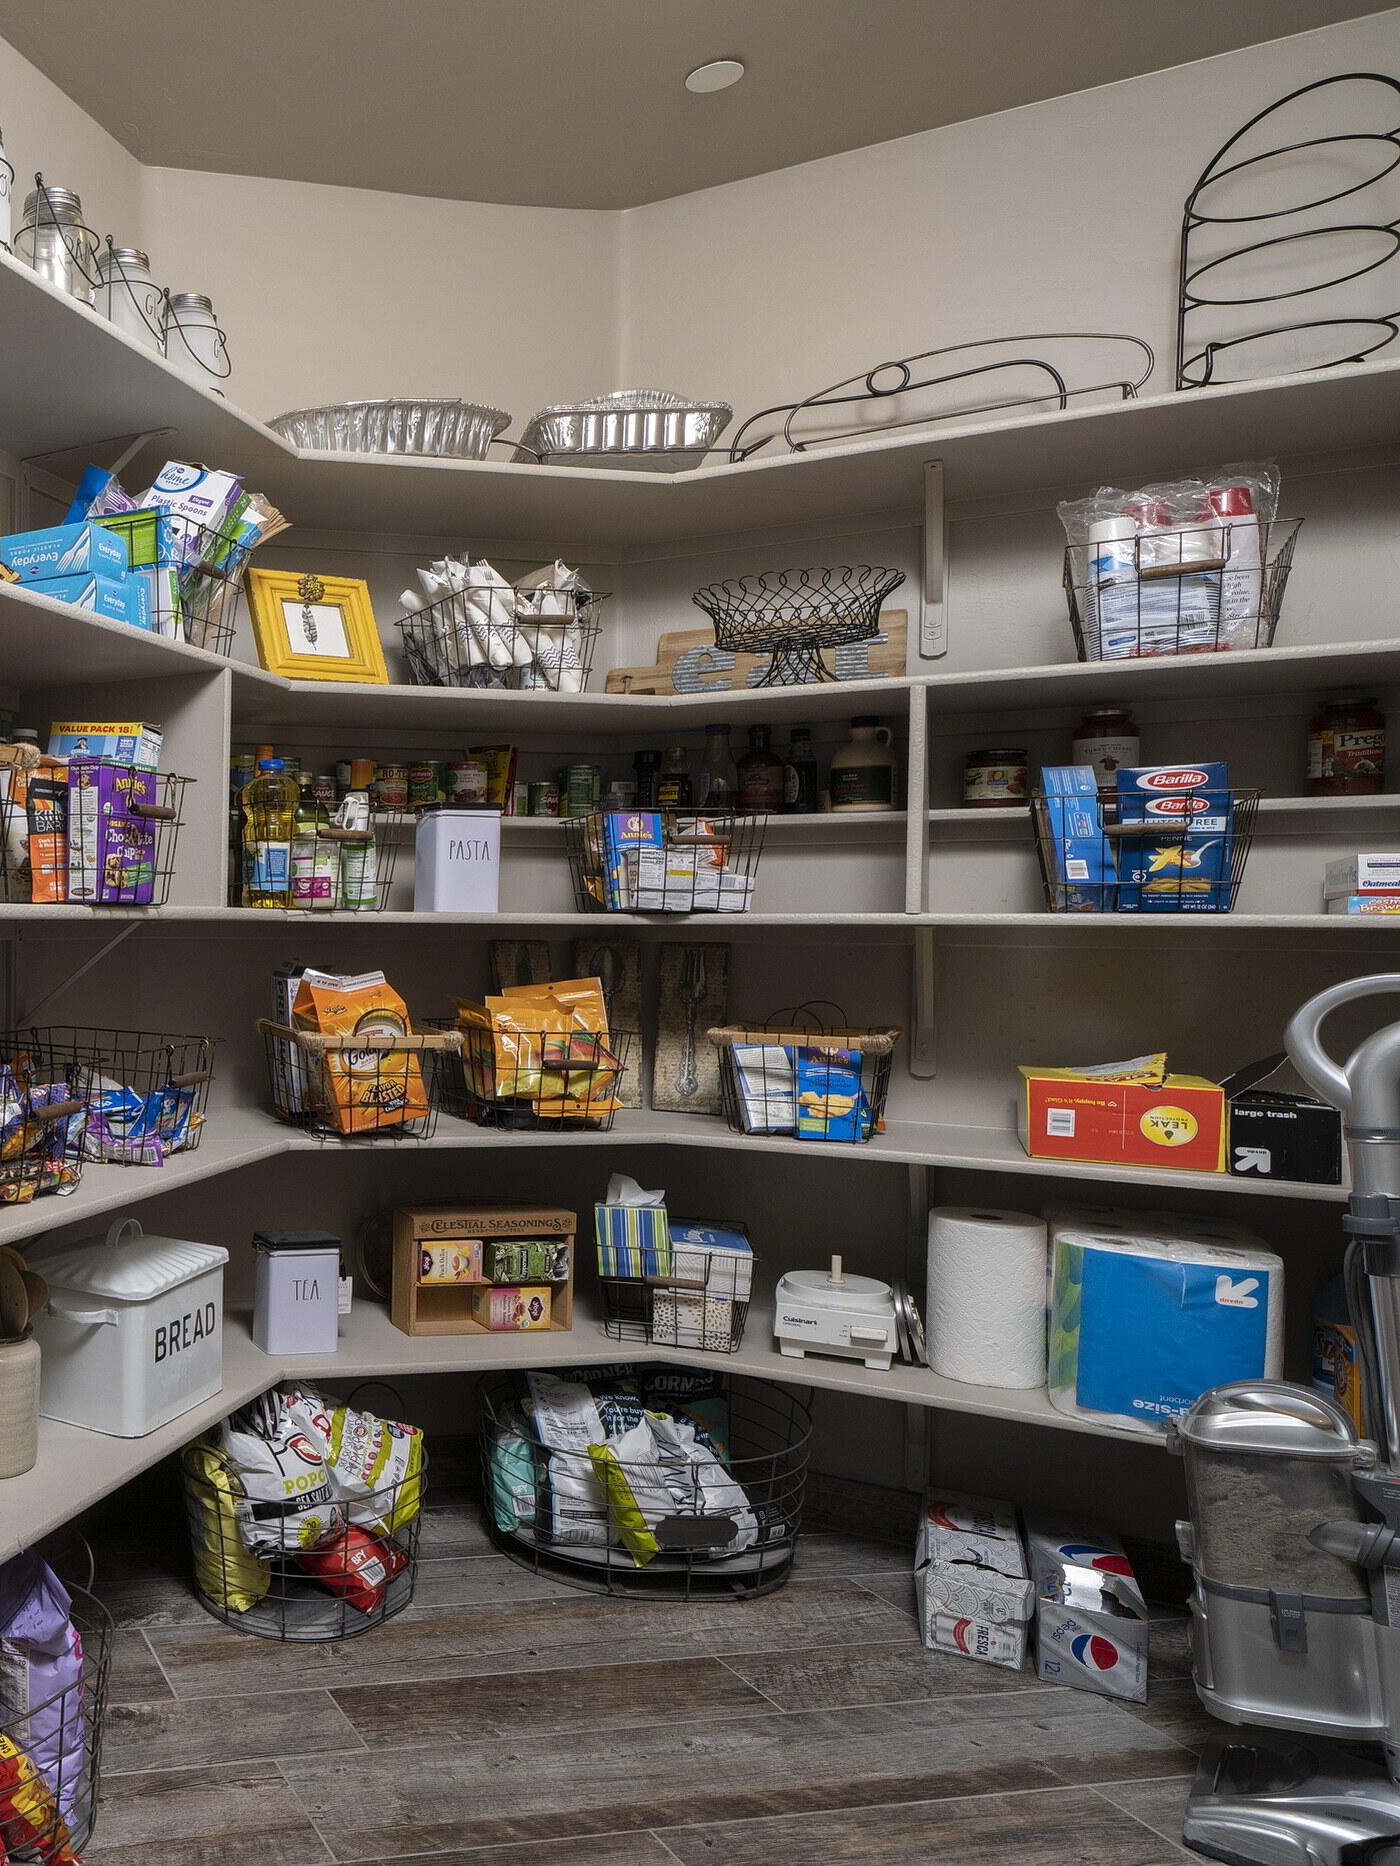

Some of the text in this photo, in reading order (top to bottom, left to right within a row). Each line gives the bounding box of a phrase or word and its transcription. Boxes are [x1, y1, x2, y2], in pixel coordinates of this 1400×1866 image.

[151, 493, 208, 516] Plastic Spoons
[11, 552, 59, 567] Everyday
[59, 725, 88, 733] VALUE
[118, 726, 130, 734] 18
[1153, 772, 1202, 787] Barilla
[1234, 1108, 1297, 1120] large trash
[1150, 1120, 1188, 1130] LEAK
[431, 1218, 563, 1234] CELESTIAL SEASONINGS
[782, 1315, 817, 1326] Cuisinart
[154, 1302, 216, 1364] BREAD
[512, 1485, 527, 1494] BFY
[351, 1549, 367, 1565] BFY
[974, 1624, 990, 1656] FRESCA
